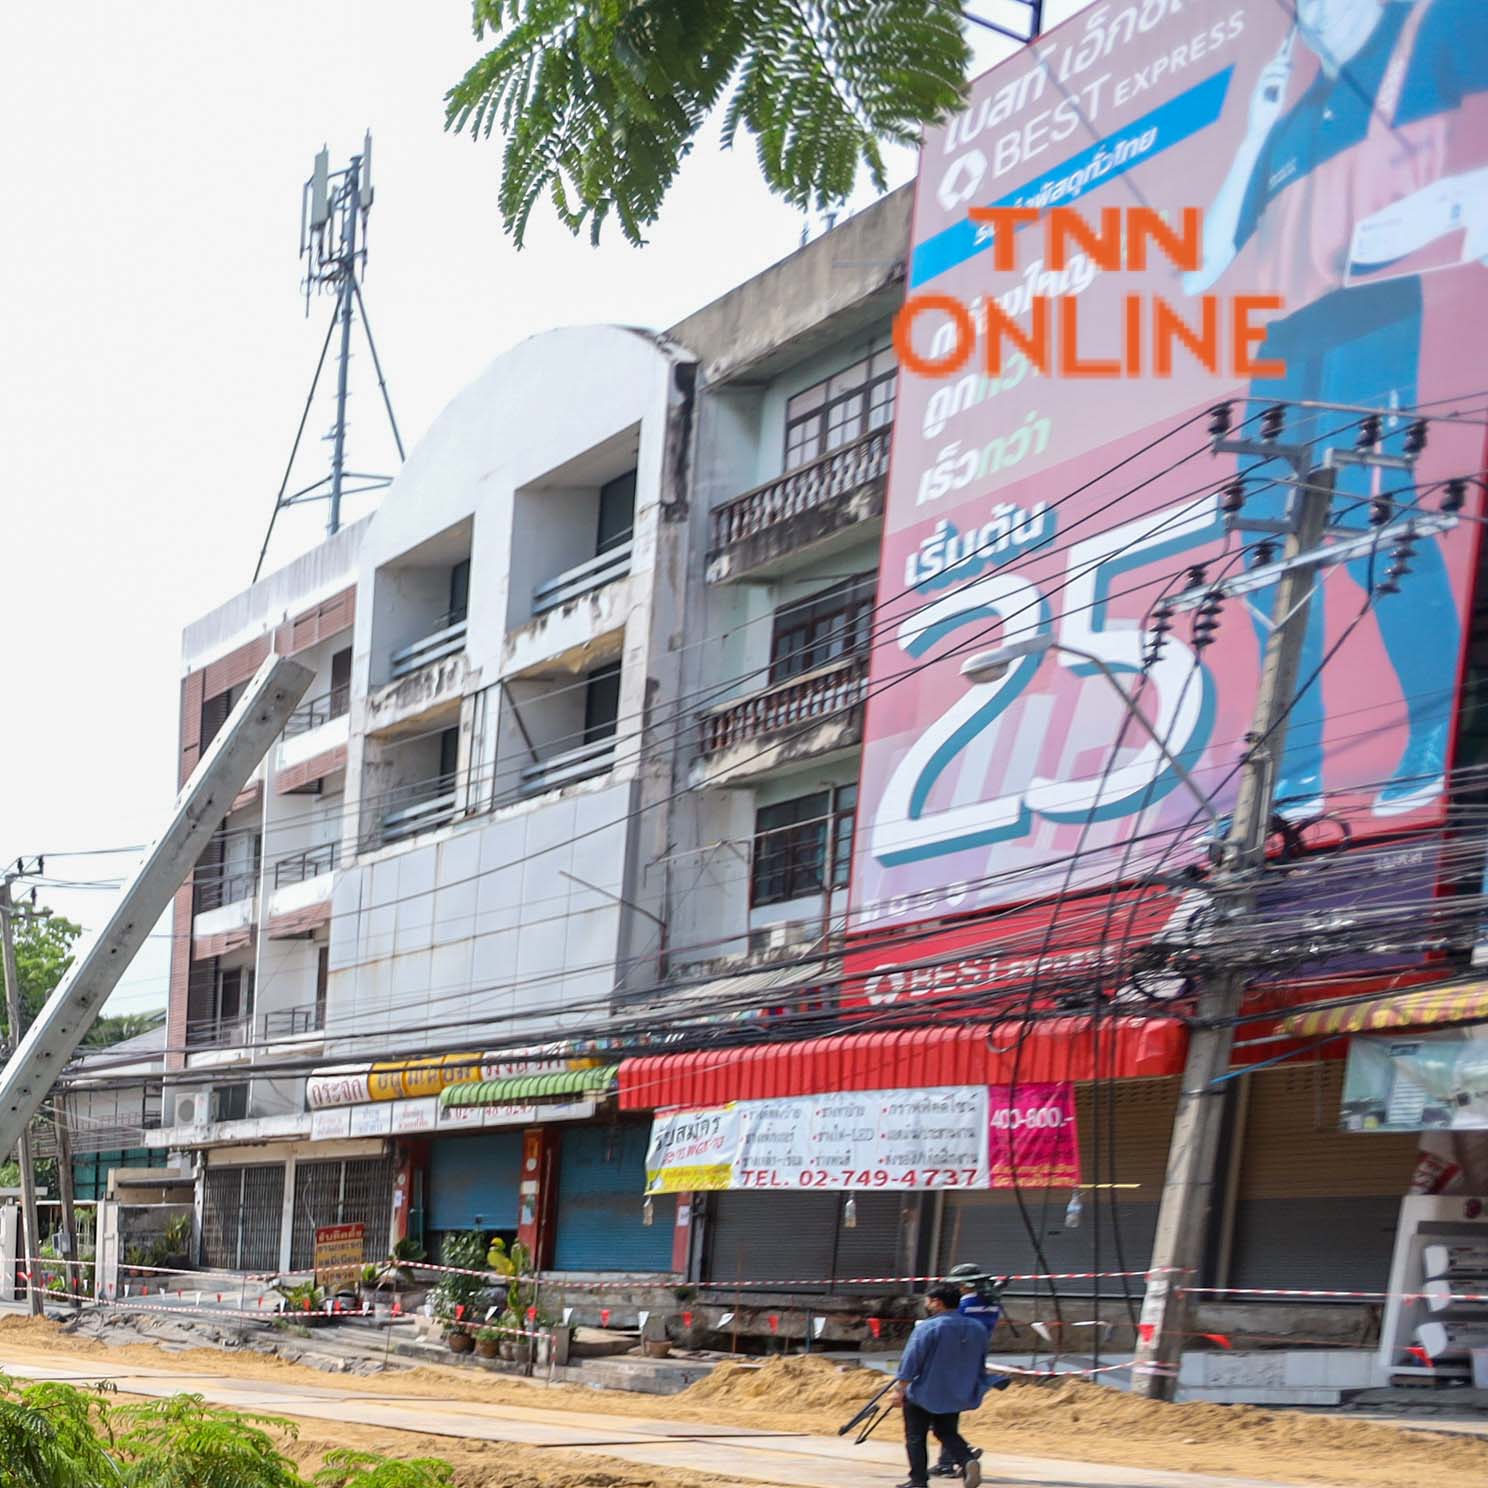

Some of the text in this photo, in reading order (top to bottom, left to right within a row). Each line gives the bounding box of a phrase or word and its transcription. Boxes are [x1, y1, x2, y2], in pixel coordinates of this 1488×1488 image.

[992, 9, 1246, 182] BEST EXPRESS
[915, 408, 1053, 507] เร็วกว่า
[905, 500, 1049, 590] เริ่มต้น
[871, 492, 1226, 866] 25
[311, 1078, 365, 1106] กระจก
[654, 1112, 722, 1151] รับสมัคร
[740, 1169, 790, 1187] TEL.
[798, 1168, 979, 1188] 02-749-4737
